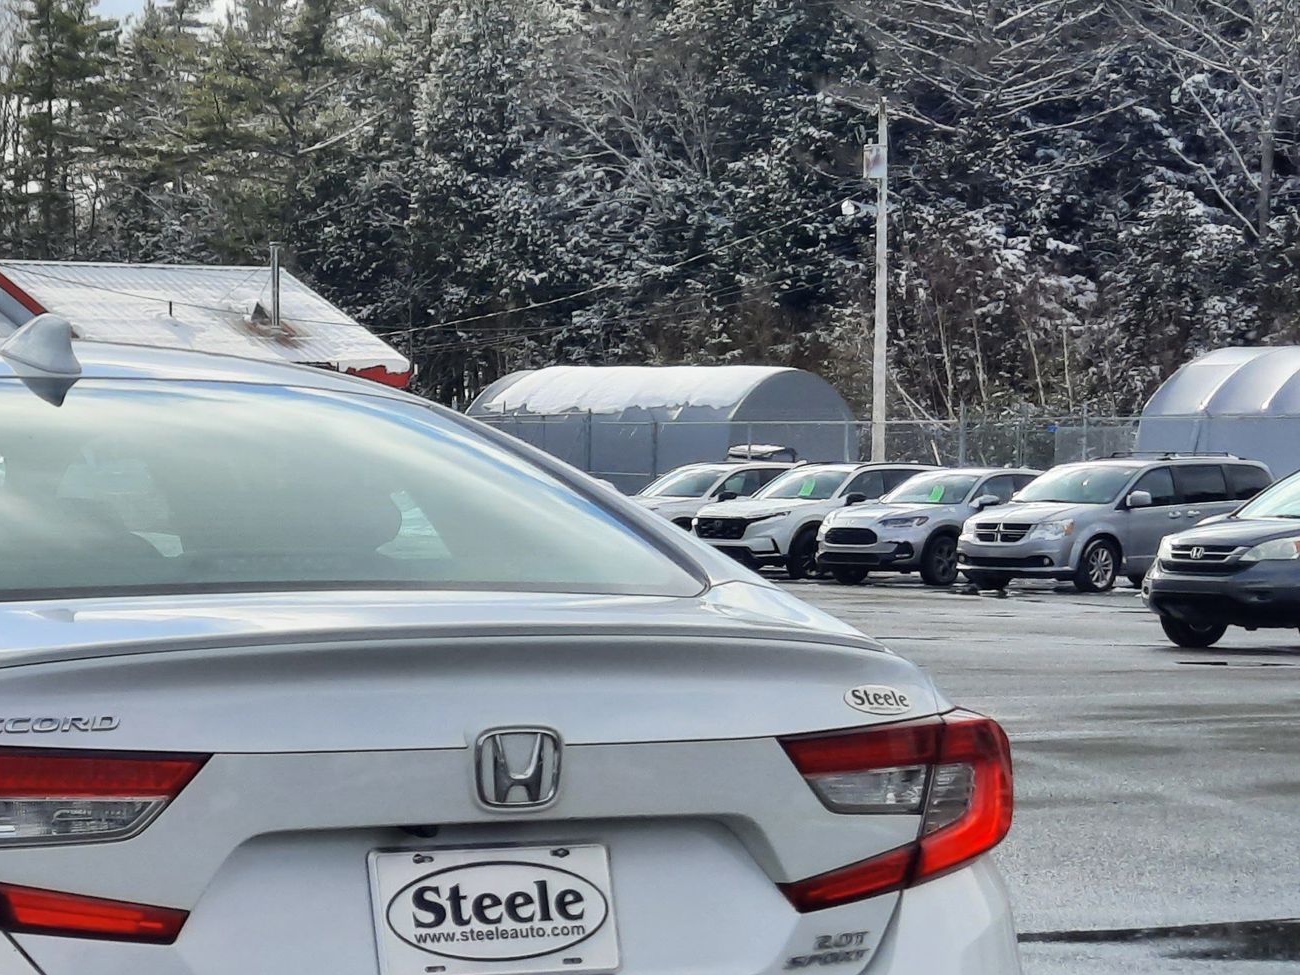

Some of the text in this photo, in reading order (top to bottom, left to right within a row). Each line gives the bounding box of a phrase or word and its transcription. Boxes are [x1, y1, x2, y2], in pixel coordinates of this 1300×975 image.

[851, 689, 910, 707] Steele
[411, 880, 586, 929] Steele
[414, 924, 586, 944] www.steeleauto.com
